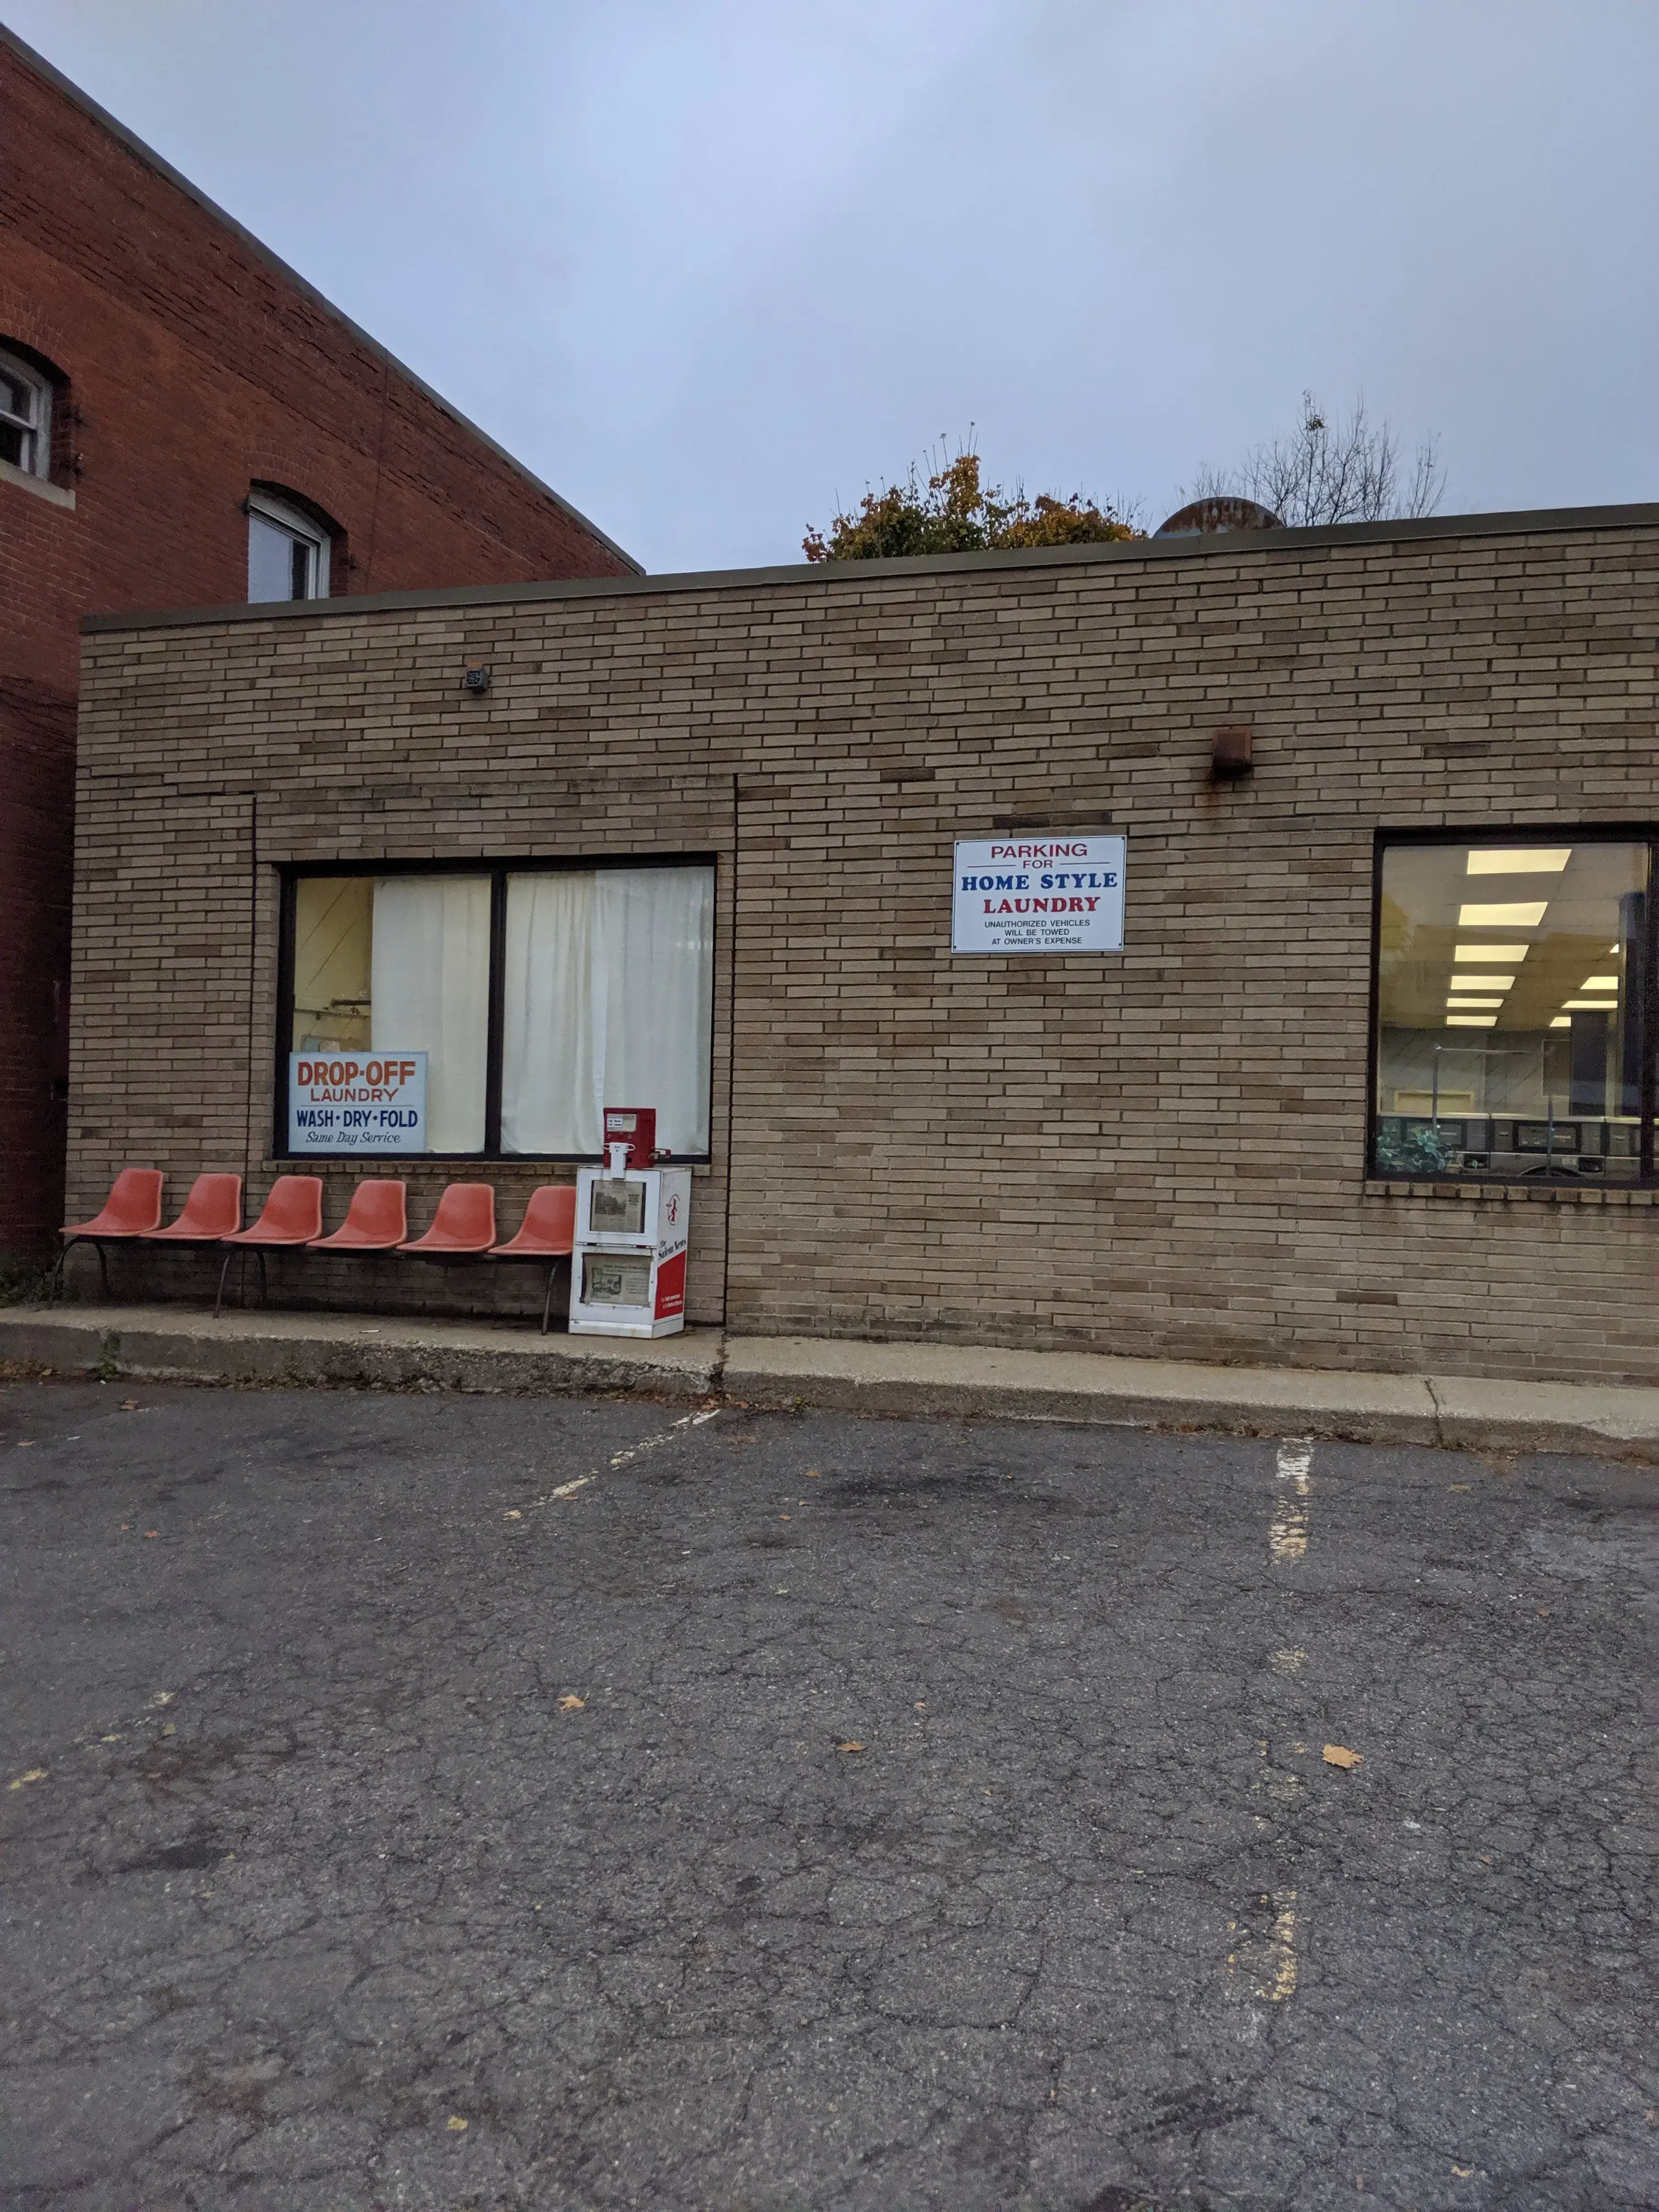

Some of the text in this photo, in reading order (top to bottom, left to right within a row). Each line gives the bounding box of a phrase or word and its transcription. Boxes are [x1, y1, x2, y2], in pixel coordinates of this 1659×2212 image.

[991, 843, 1087, 859] PARKING
[1023, 860, 1053, 869] FOR
[961, 872, 1118, 891] HOME STYLE
[983, 896, 1102, 914] LAUNDRY
[298, 1060, 416, 1086] DROP-OFF
[310, 1088, 399, 1102] LAUNDRY
[297, 1110, 418, 1128] WASH DRY FOLD
[305, 1131, 402, 1146] Same Day Service
